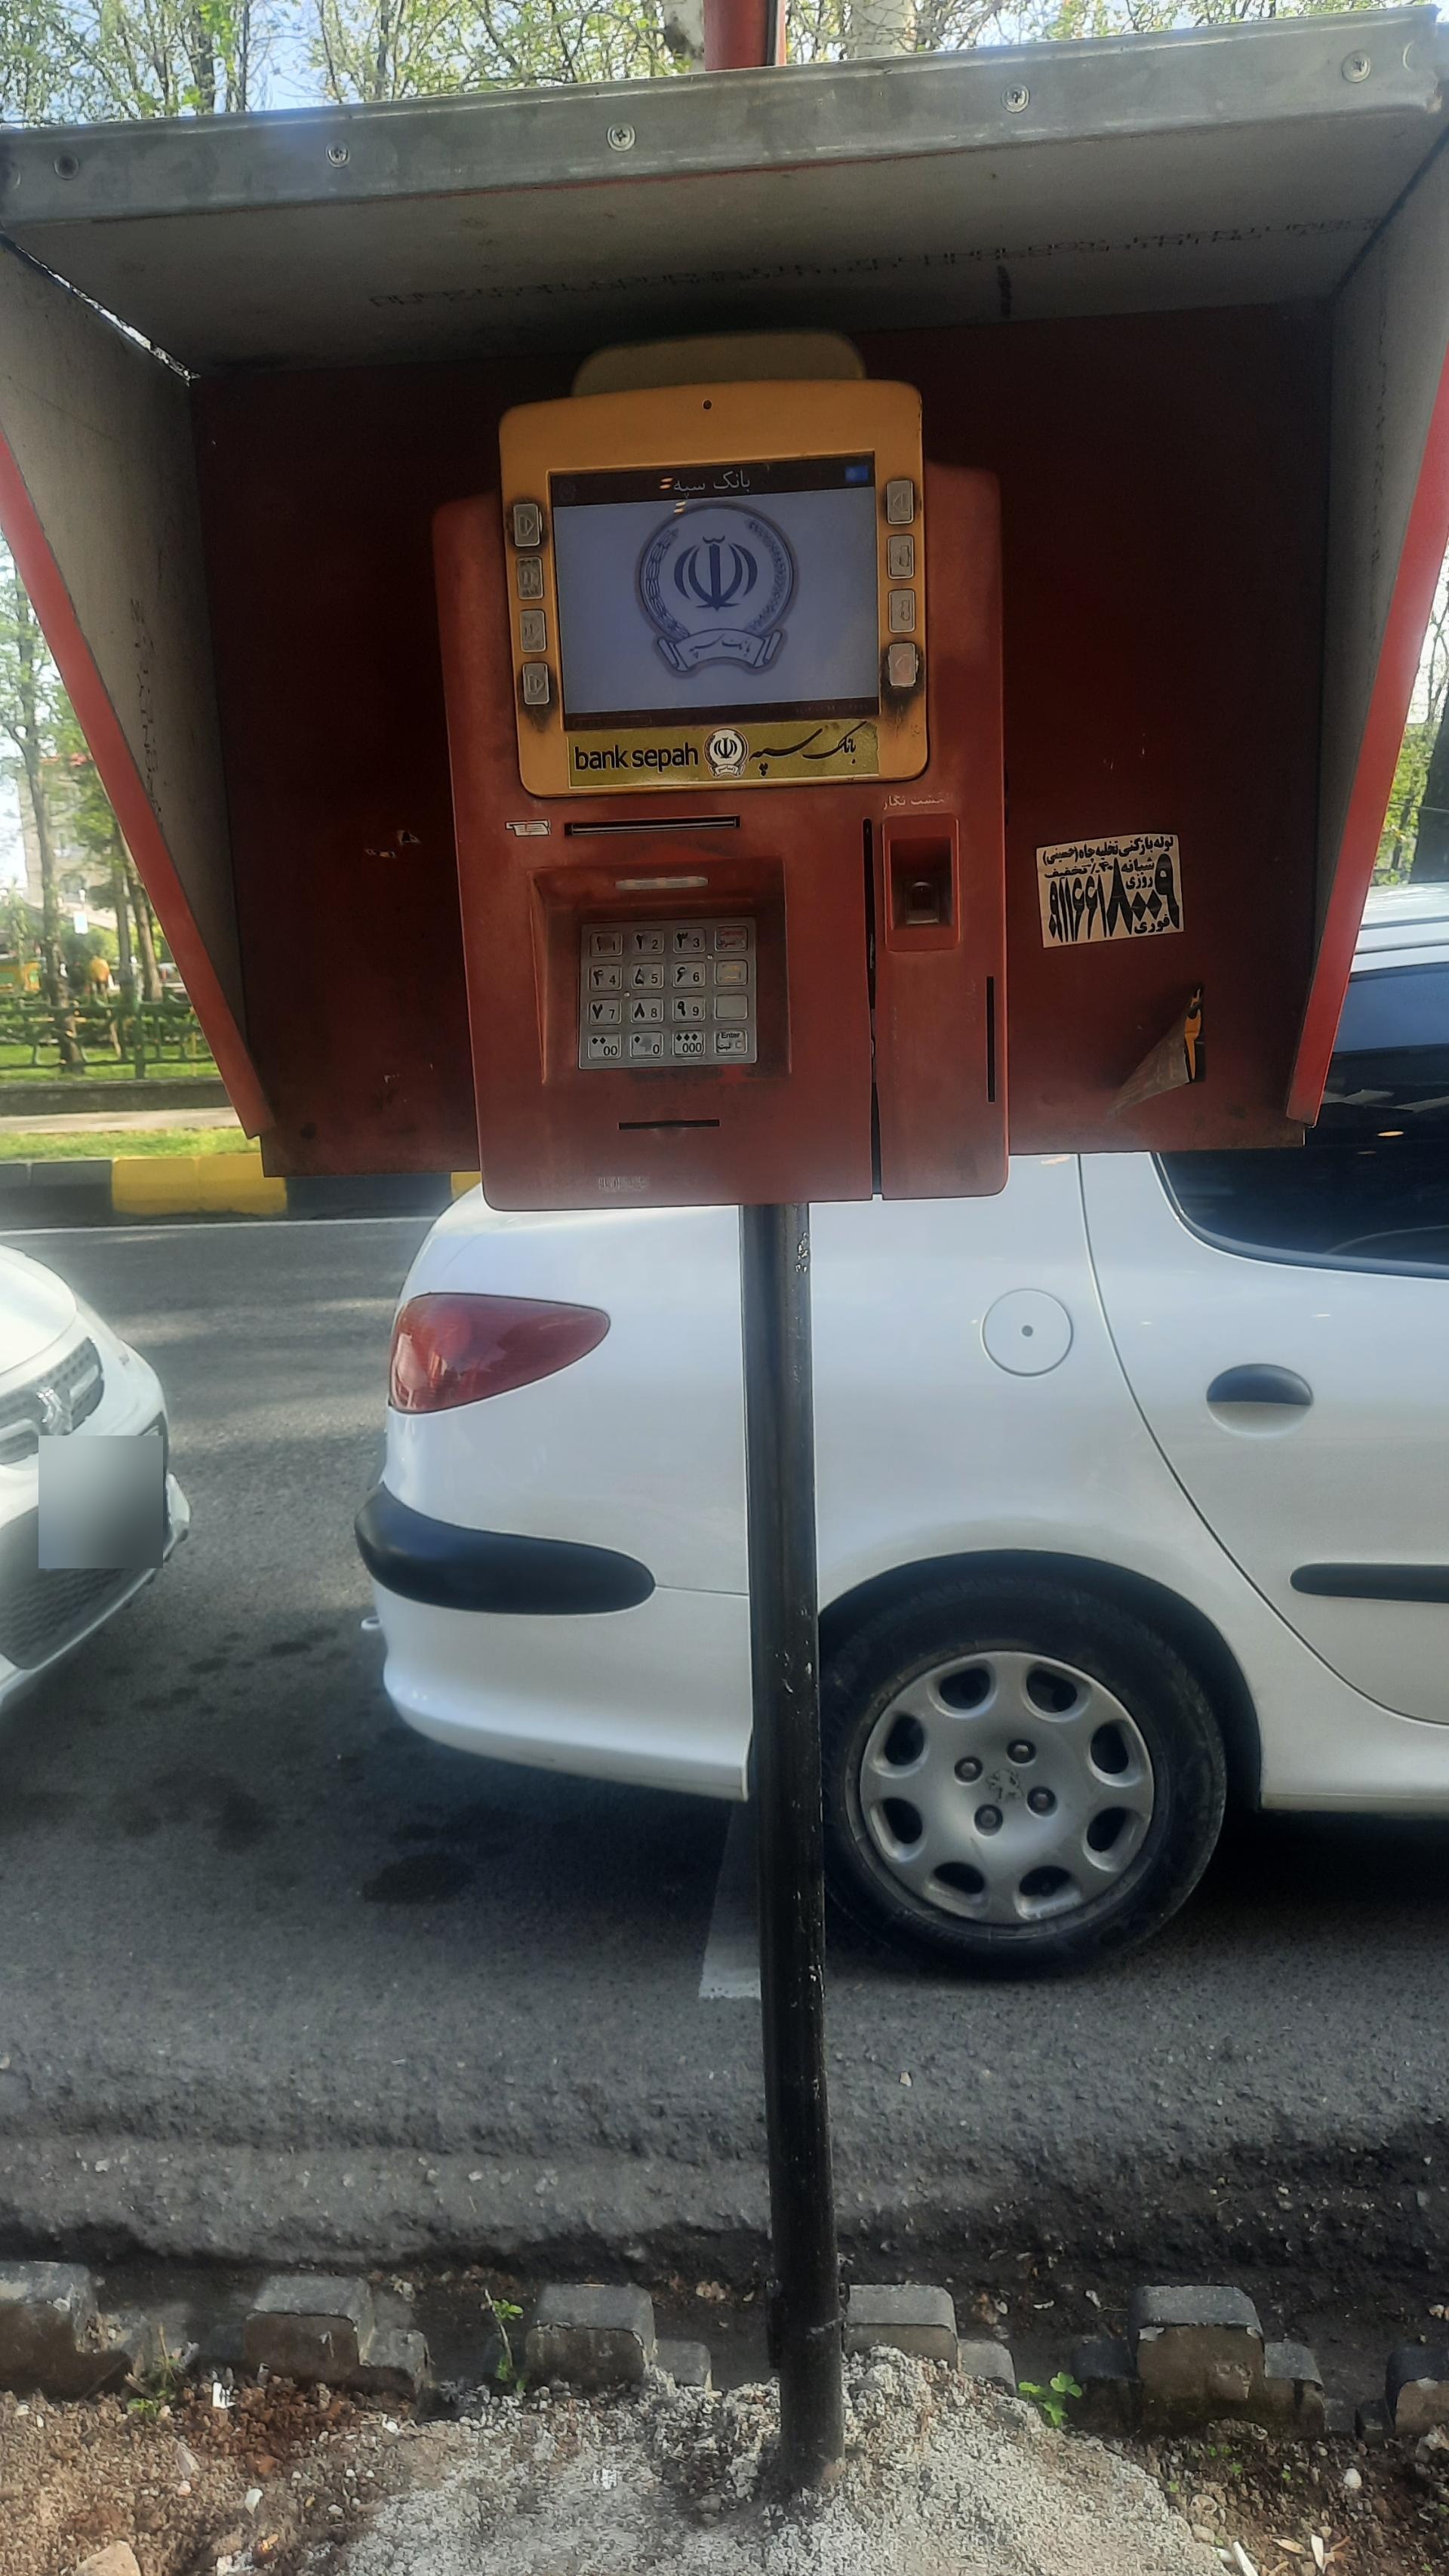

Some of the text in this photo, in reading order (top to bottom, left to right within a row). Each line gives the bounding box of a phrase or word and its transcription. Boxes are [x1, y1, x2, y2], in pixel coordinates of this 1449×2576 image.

[673, 471, 750, 498] بانک سپه
[749, 721, 868, 775] بانک سپه
[574, 742, 698, 772] bank sepah
[882, 795, 906, 811] نگار
[1096, 840, 1118, 860] تخلیه
[1154, 836, 1173, 851] لوله
[1079, 844, 1095, 863] چاه
[1044, 864, 1091, 879] تخفیف
[1121, 857, 1155, 874] شبانه
[1126, 874, 1153, 889] روزی
[1134, 913, 1171, 934] فوری
[652, 940, 659, 949] 2
[693, 937, 700, 948] 3
[609, 975, 616, 985] 4
[693, 972, 700, 982] 6
[609, 1009, 615, 1019] 7
[651, 1008, 657, 1018] 8
[692, 1006, 699, 1016] 9
